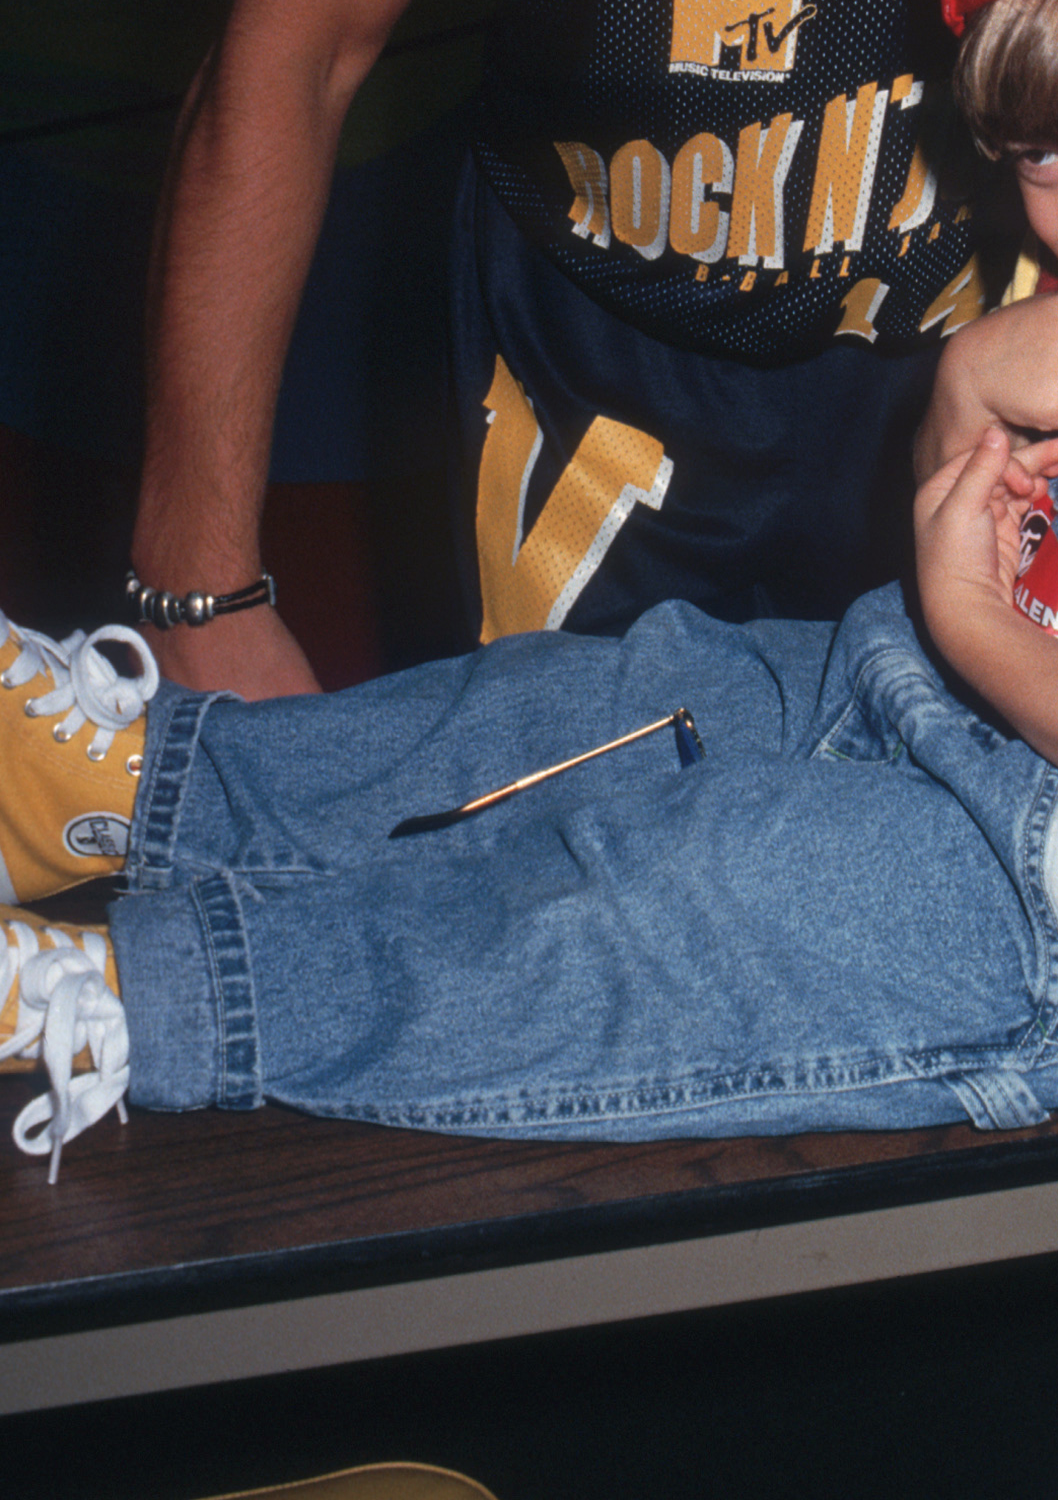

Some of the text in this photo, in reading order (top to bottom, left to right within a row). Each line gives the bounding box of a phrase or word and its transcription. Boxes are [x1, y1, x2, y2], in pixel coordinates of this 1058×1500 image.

[669, 62, 785, 83] MUSIC TELEVISION
[554, 113, 804, 268] ROCK
